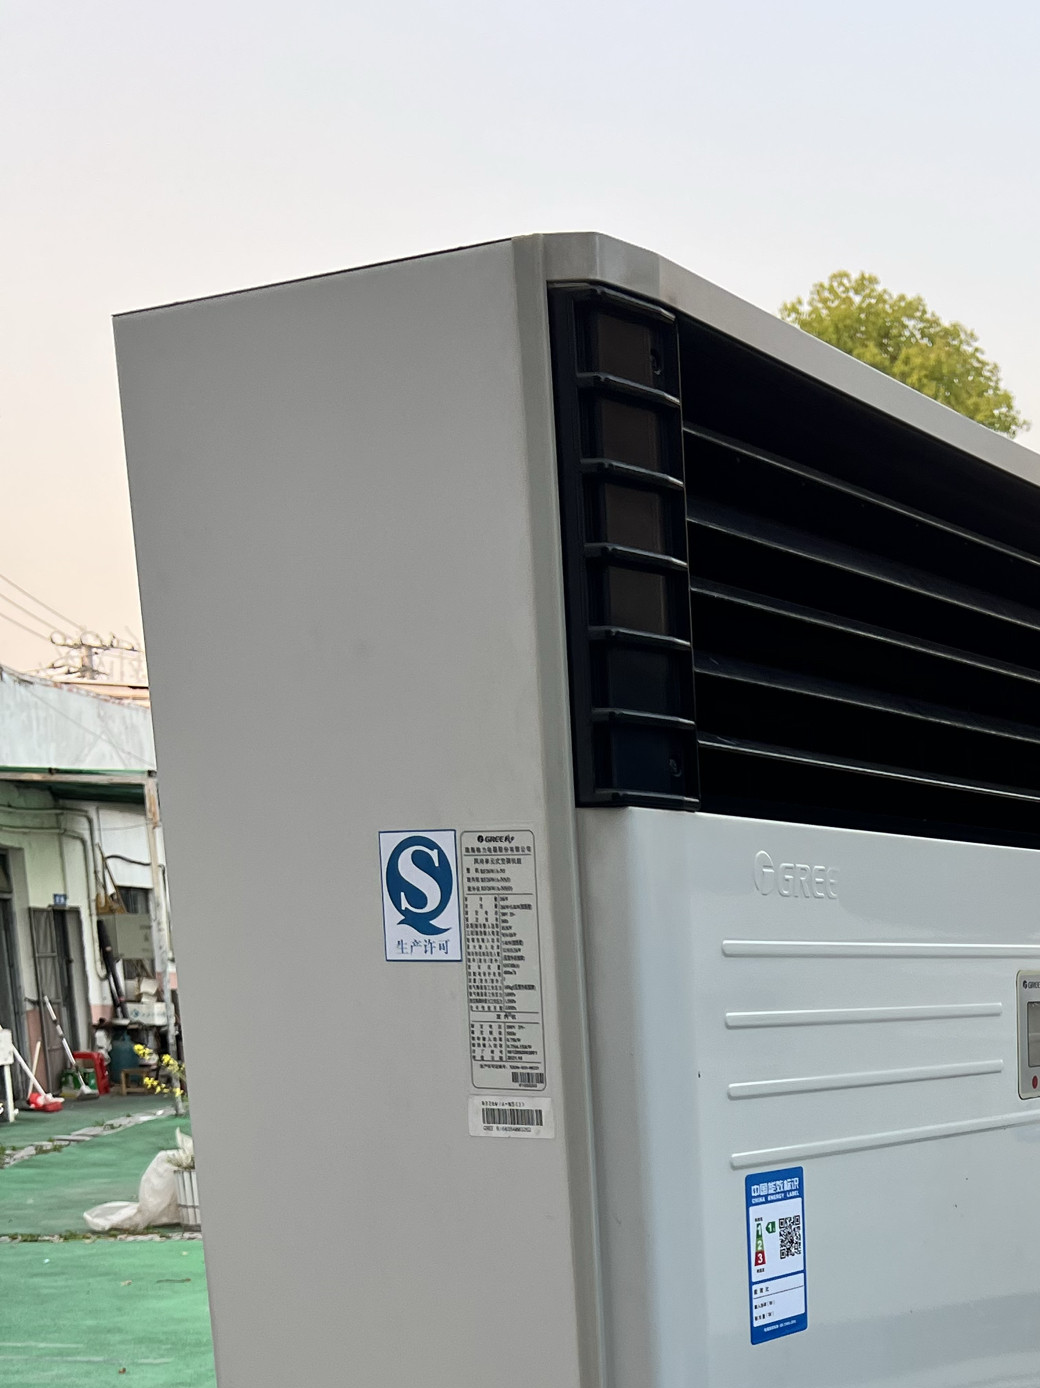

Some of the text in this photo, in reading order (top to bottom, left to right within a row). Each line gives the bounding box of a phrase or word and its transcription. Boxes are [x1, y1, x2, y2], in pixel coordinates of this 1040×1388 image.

[778, 862, 841, 900] GREE
[397, 938, 451, 956] 生产许可
[751, 1177, 800, 1197] 中国能效标识
[767, 1193, 785, 1201] ENERGY
[786, 1190, 800, 1198] LABEL
